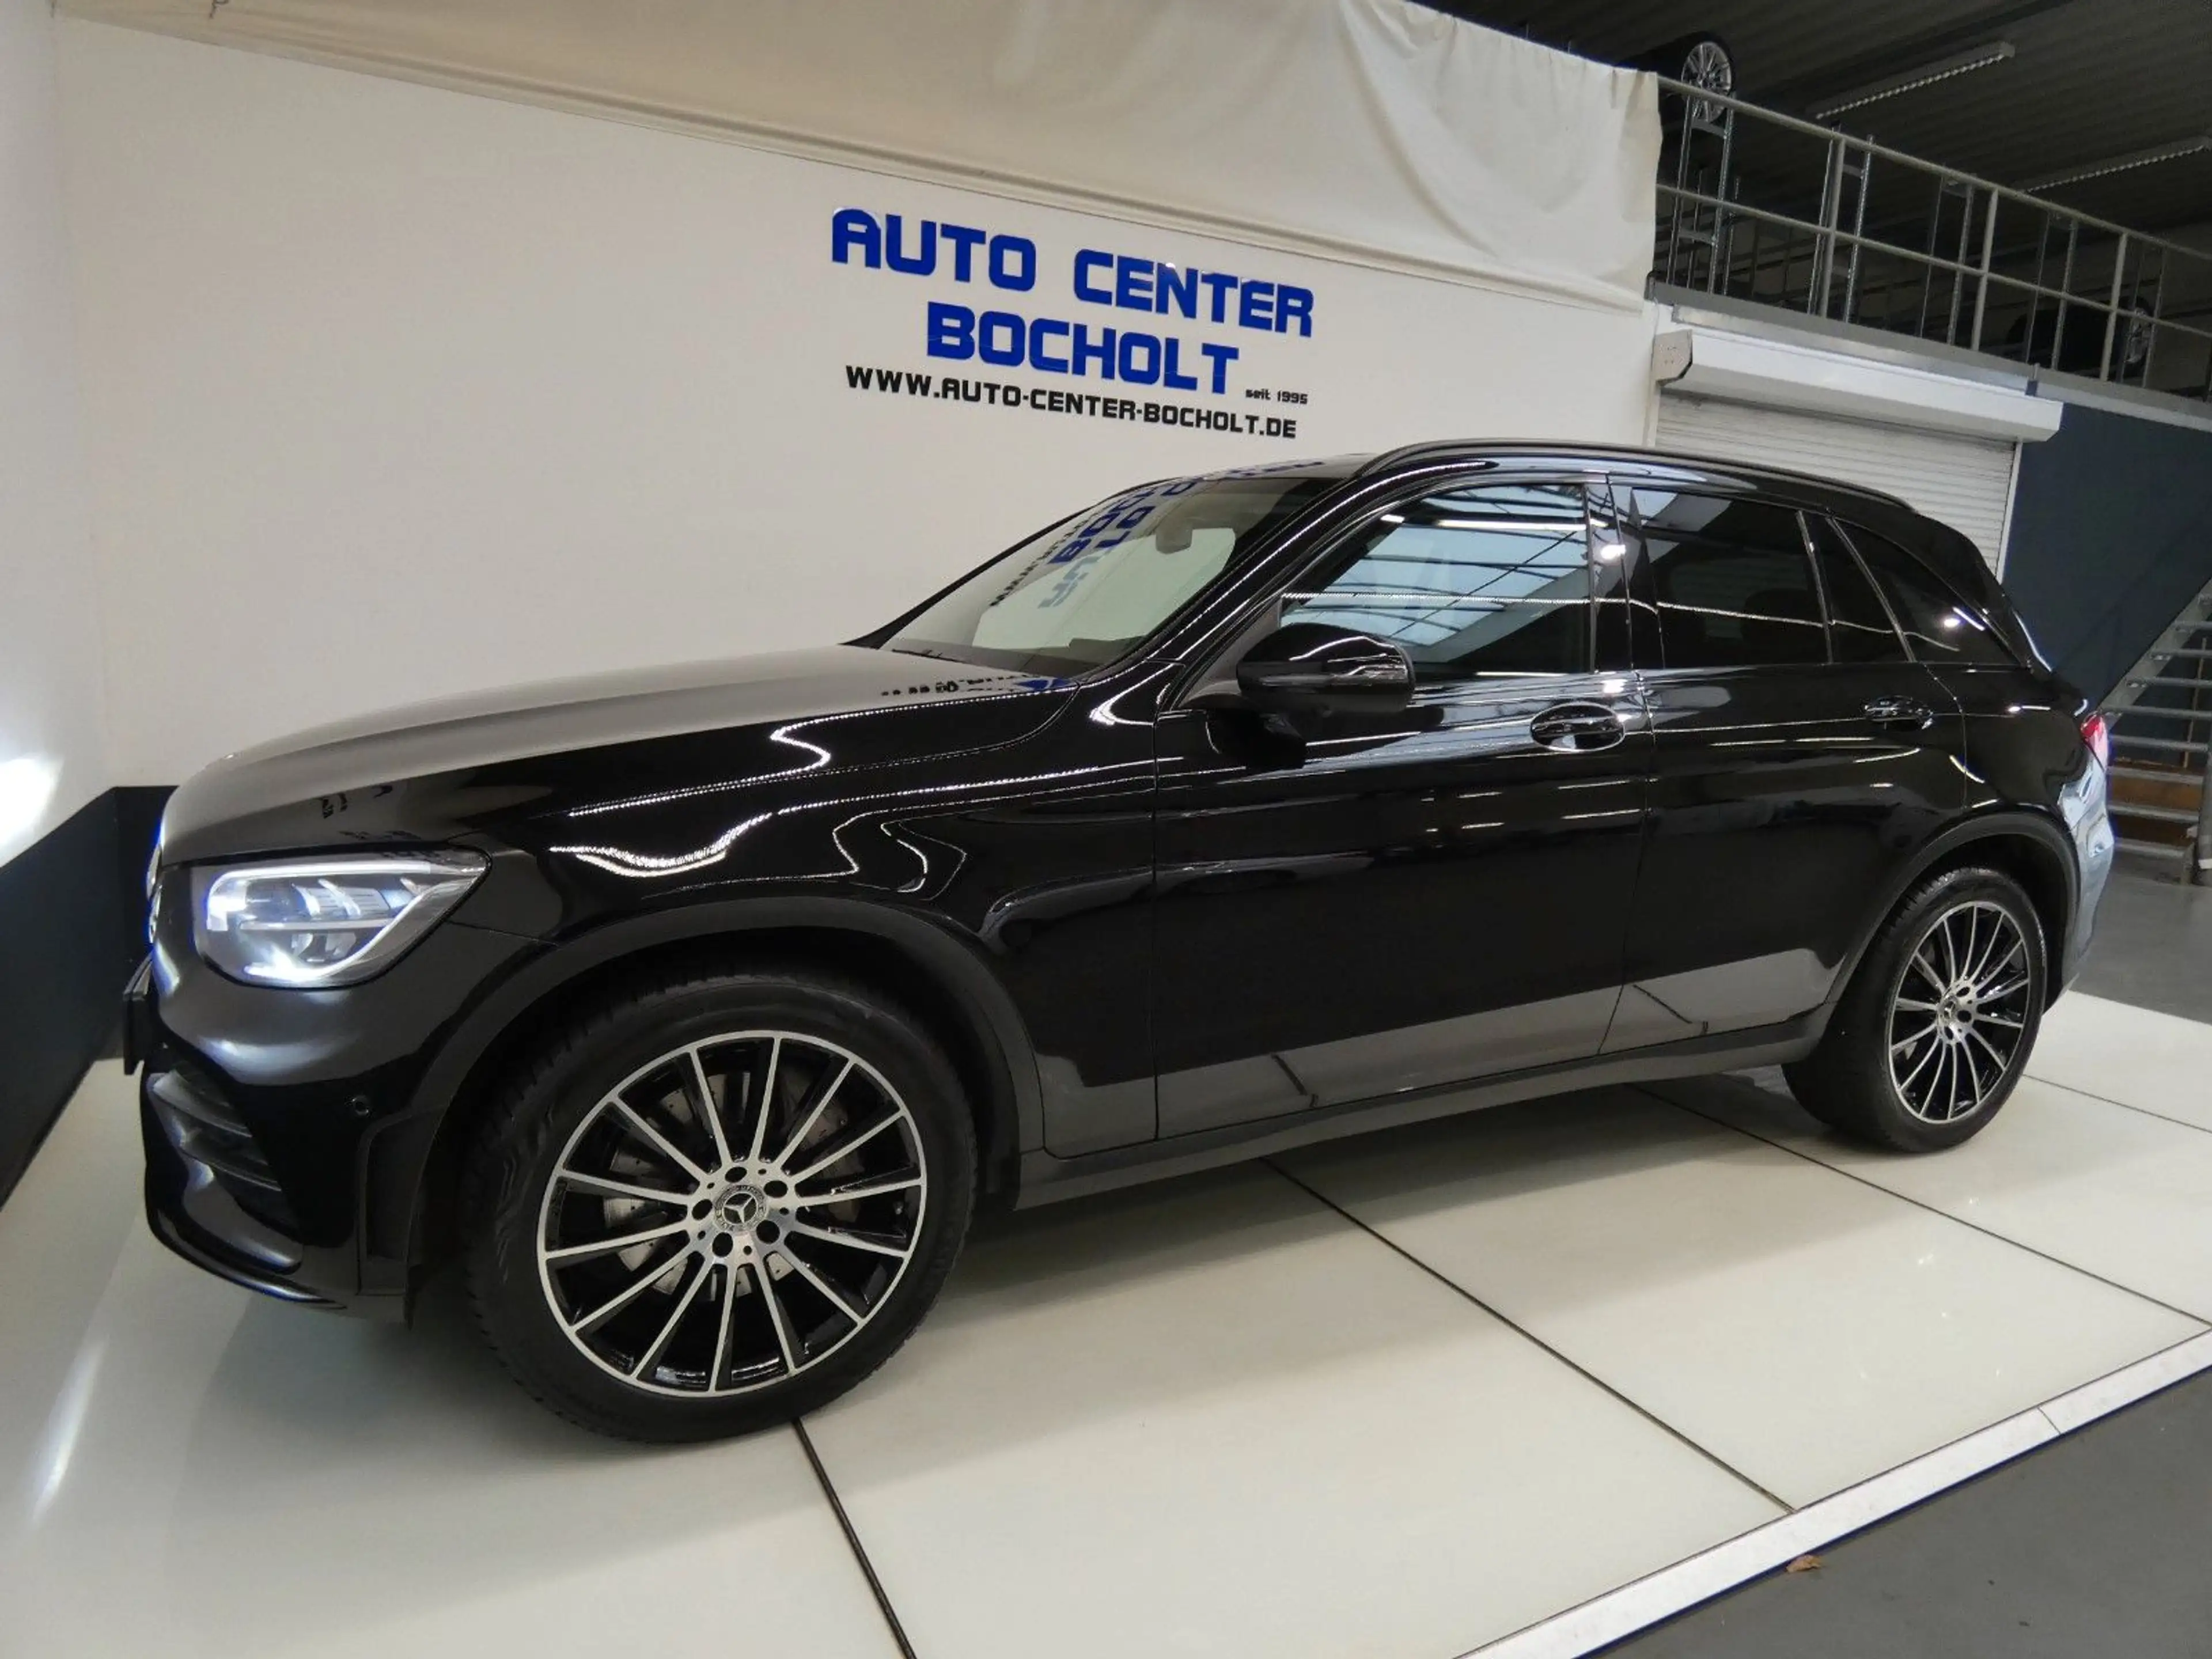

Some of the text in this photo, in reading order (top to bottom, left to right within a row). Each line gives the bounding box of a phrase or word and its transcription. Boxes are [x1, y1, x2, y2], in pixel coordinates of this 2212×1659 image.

[832, 208, 1315, 338] AUTO CENTER
[927, 301, 1240, 394] BOCHOLT
[846, 365, 1297, 439] WWW.AUTO-CENTER-BOCHOLT.DE
[1245, 388, 1308, 404] seit 1995
